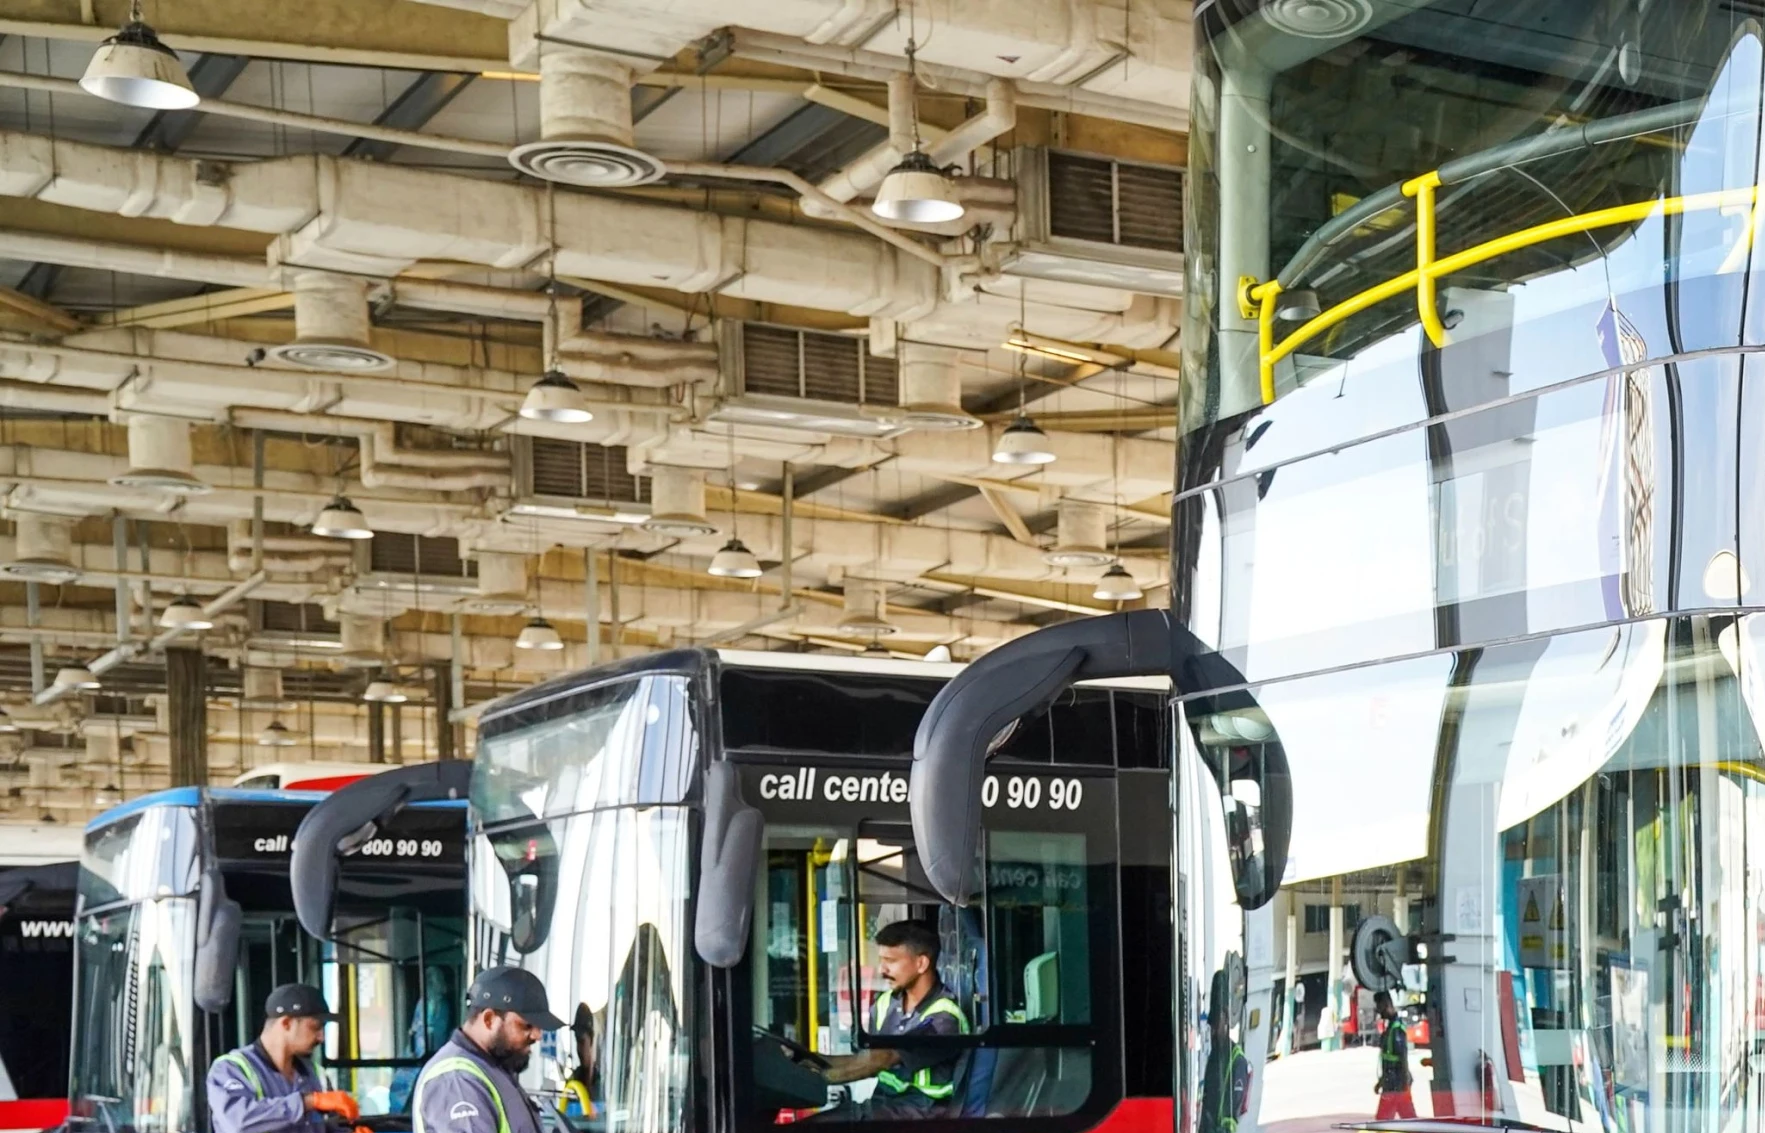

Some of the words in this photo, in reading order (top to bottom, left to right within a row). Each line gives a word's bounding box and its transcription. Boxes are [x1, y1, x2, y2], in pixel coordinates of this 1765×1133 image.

[759, 767, 817, 800] call
[823, 770, 911, 803] cente
[1006, 776, 1042, 809] 90
[1048, 778, 1083, 811] 90
[254, 835, 288, 852] call
[396, 839, 418, 857] 90
[420, 840, 443, 857] 90
